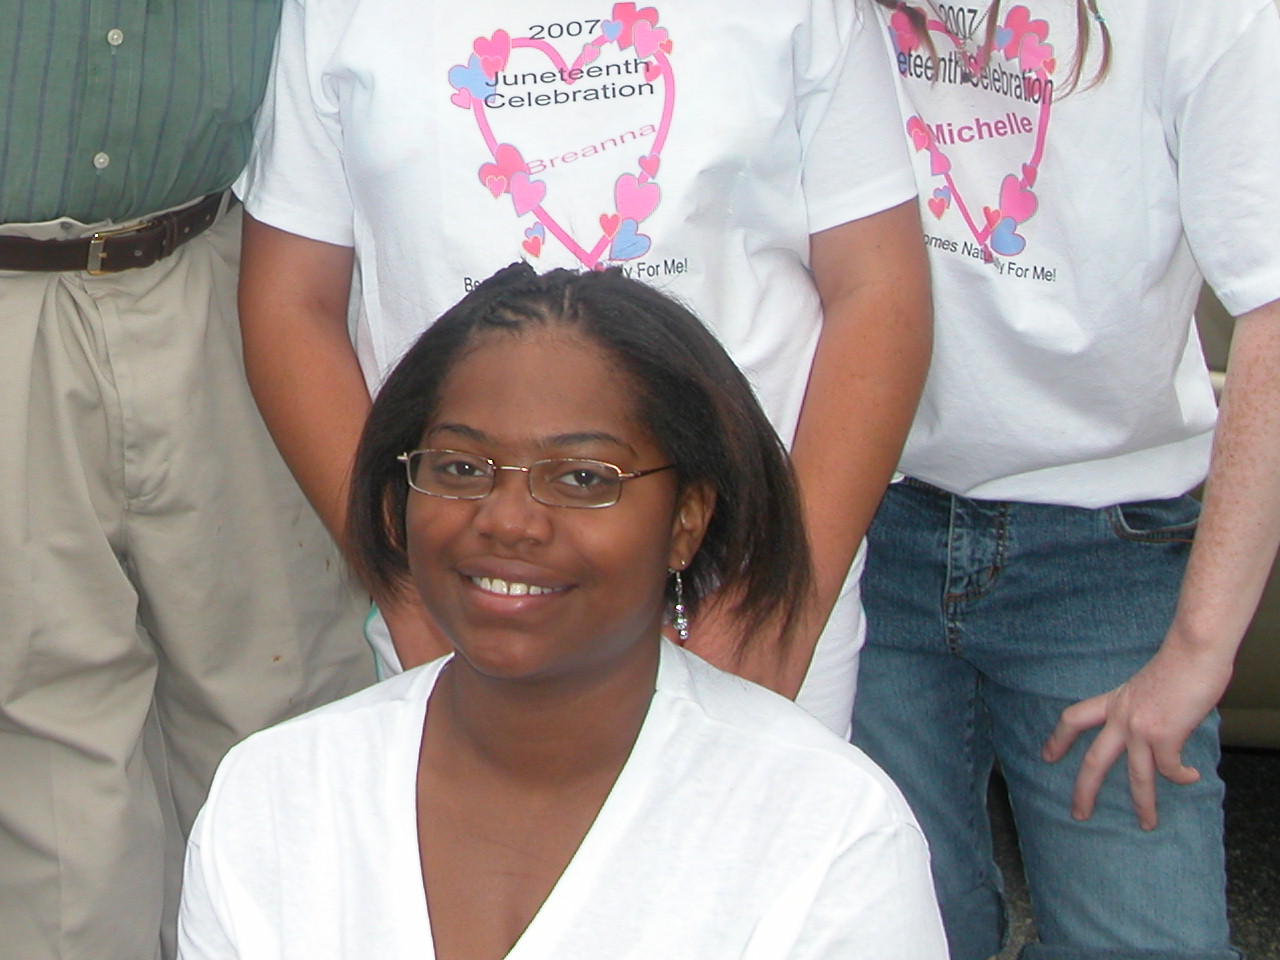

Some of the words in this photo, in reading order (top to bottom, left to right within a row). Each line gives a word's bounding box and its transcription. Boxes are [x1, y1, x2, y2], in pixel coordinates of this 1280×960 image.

[528, 19, 601, 40] 2007
[939, 4, 978, 40] 2007
[484, 58, 651, 87] Juneteenth
[897, 48, 963, 85] eteenth
[484, 83, 655, 110] Celebration
[927, 113, 1033, 145] Michelle
[527, 123, 657, 175] Breanna
[637, 262, 660, 278] For
[664, 258, 688, 276] Me!
[923, 234, 958, 252] omes
[1007, 262, 1029, 278] For
[1032, 265, 1056, 282] Me!
